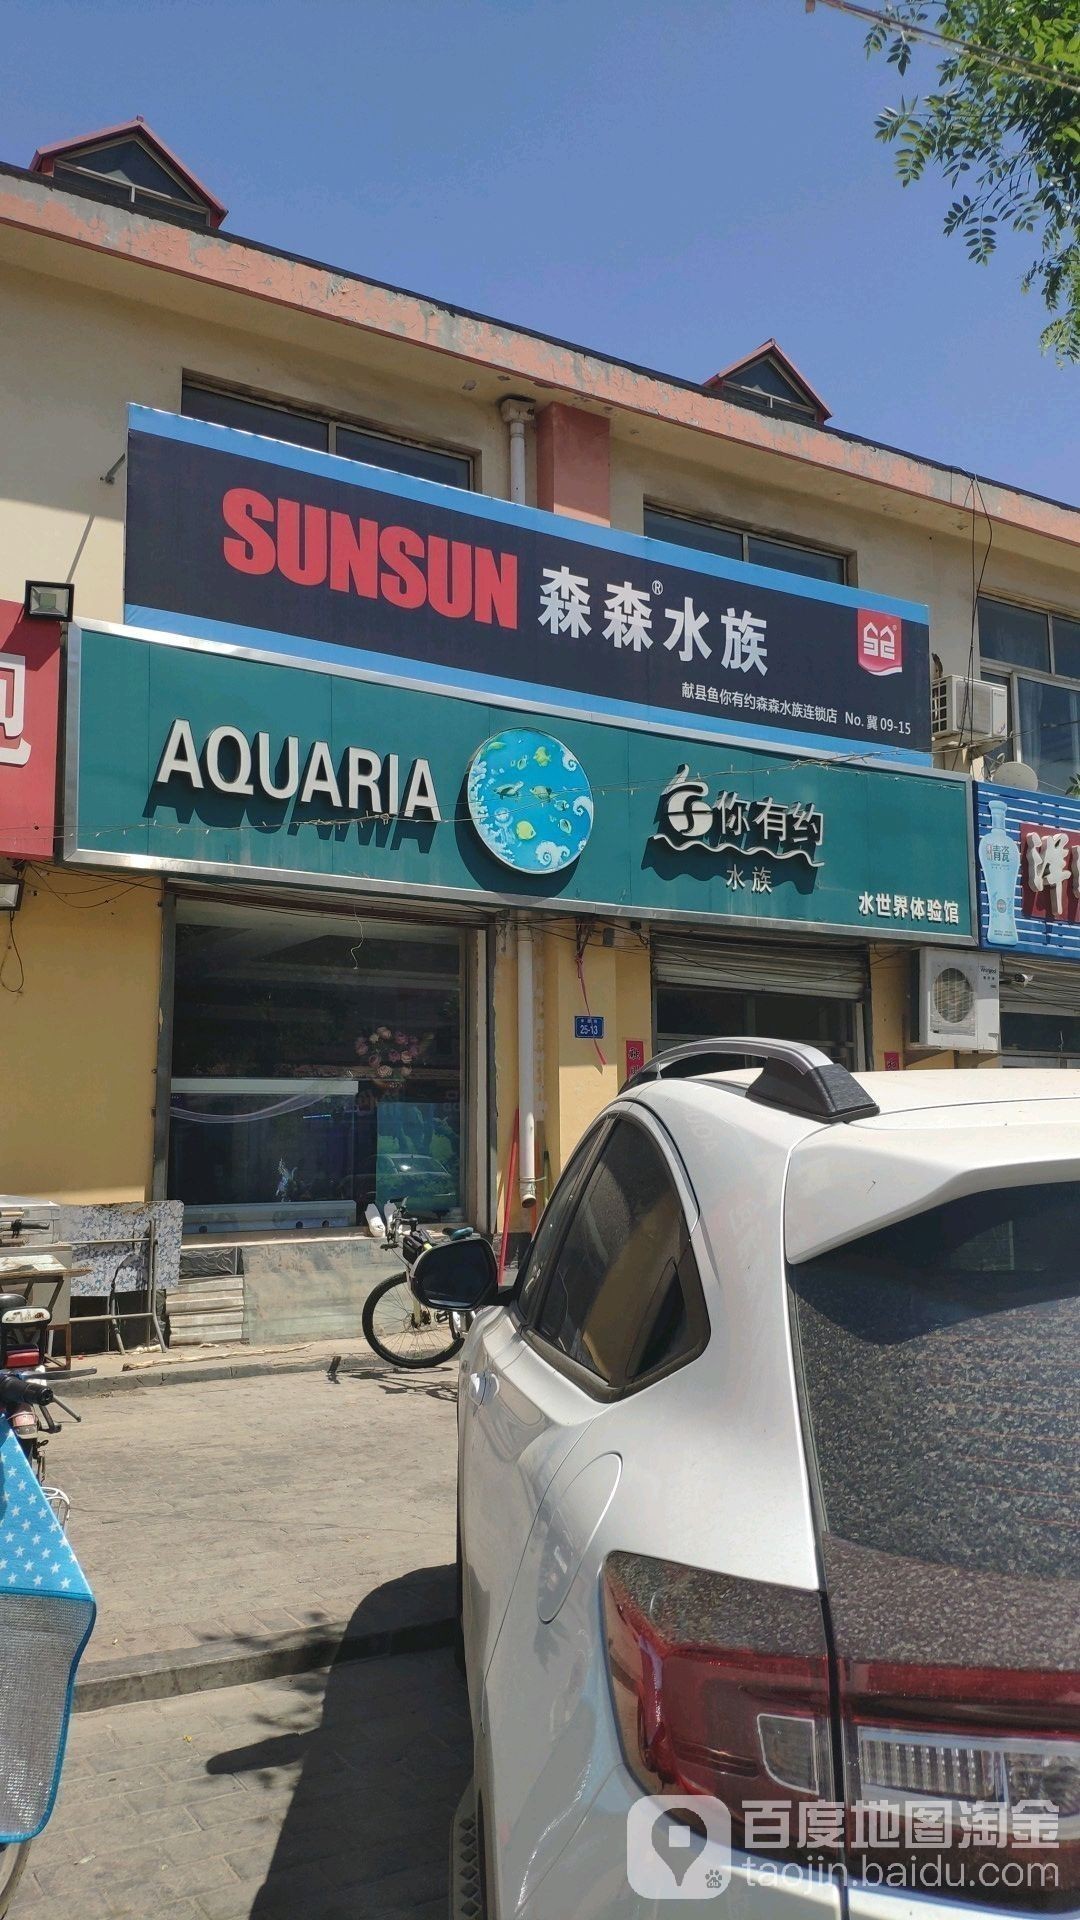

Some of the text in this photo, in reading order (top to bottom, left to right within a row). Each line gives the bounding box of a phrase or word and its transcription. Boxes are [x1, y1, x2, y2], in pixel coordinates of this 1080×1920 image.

[222, 487, 518, 630] SUNSUN
[681, 682, 838, 724] 献县鱼你有约森森水族连锁店
[844, 711, 865, 728] No.
[880, 717, 911, 735] 09-15
[156, 718, 442, 822] AQUARIA
[725, 863, 775, 894] 水族
[858, 891, 960, 924] 水世界体验馆
[580, 1025, 598, 1035] 25-13
